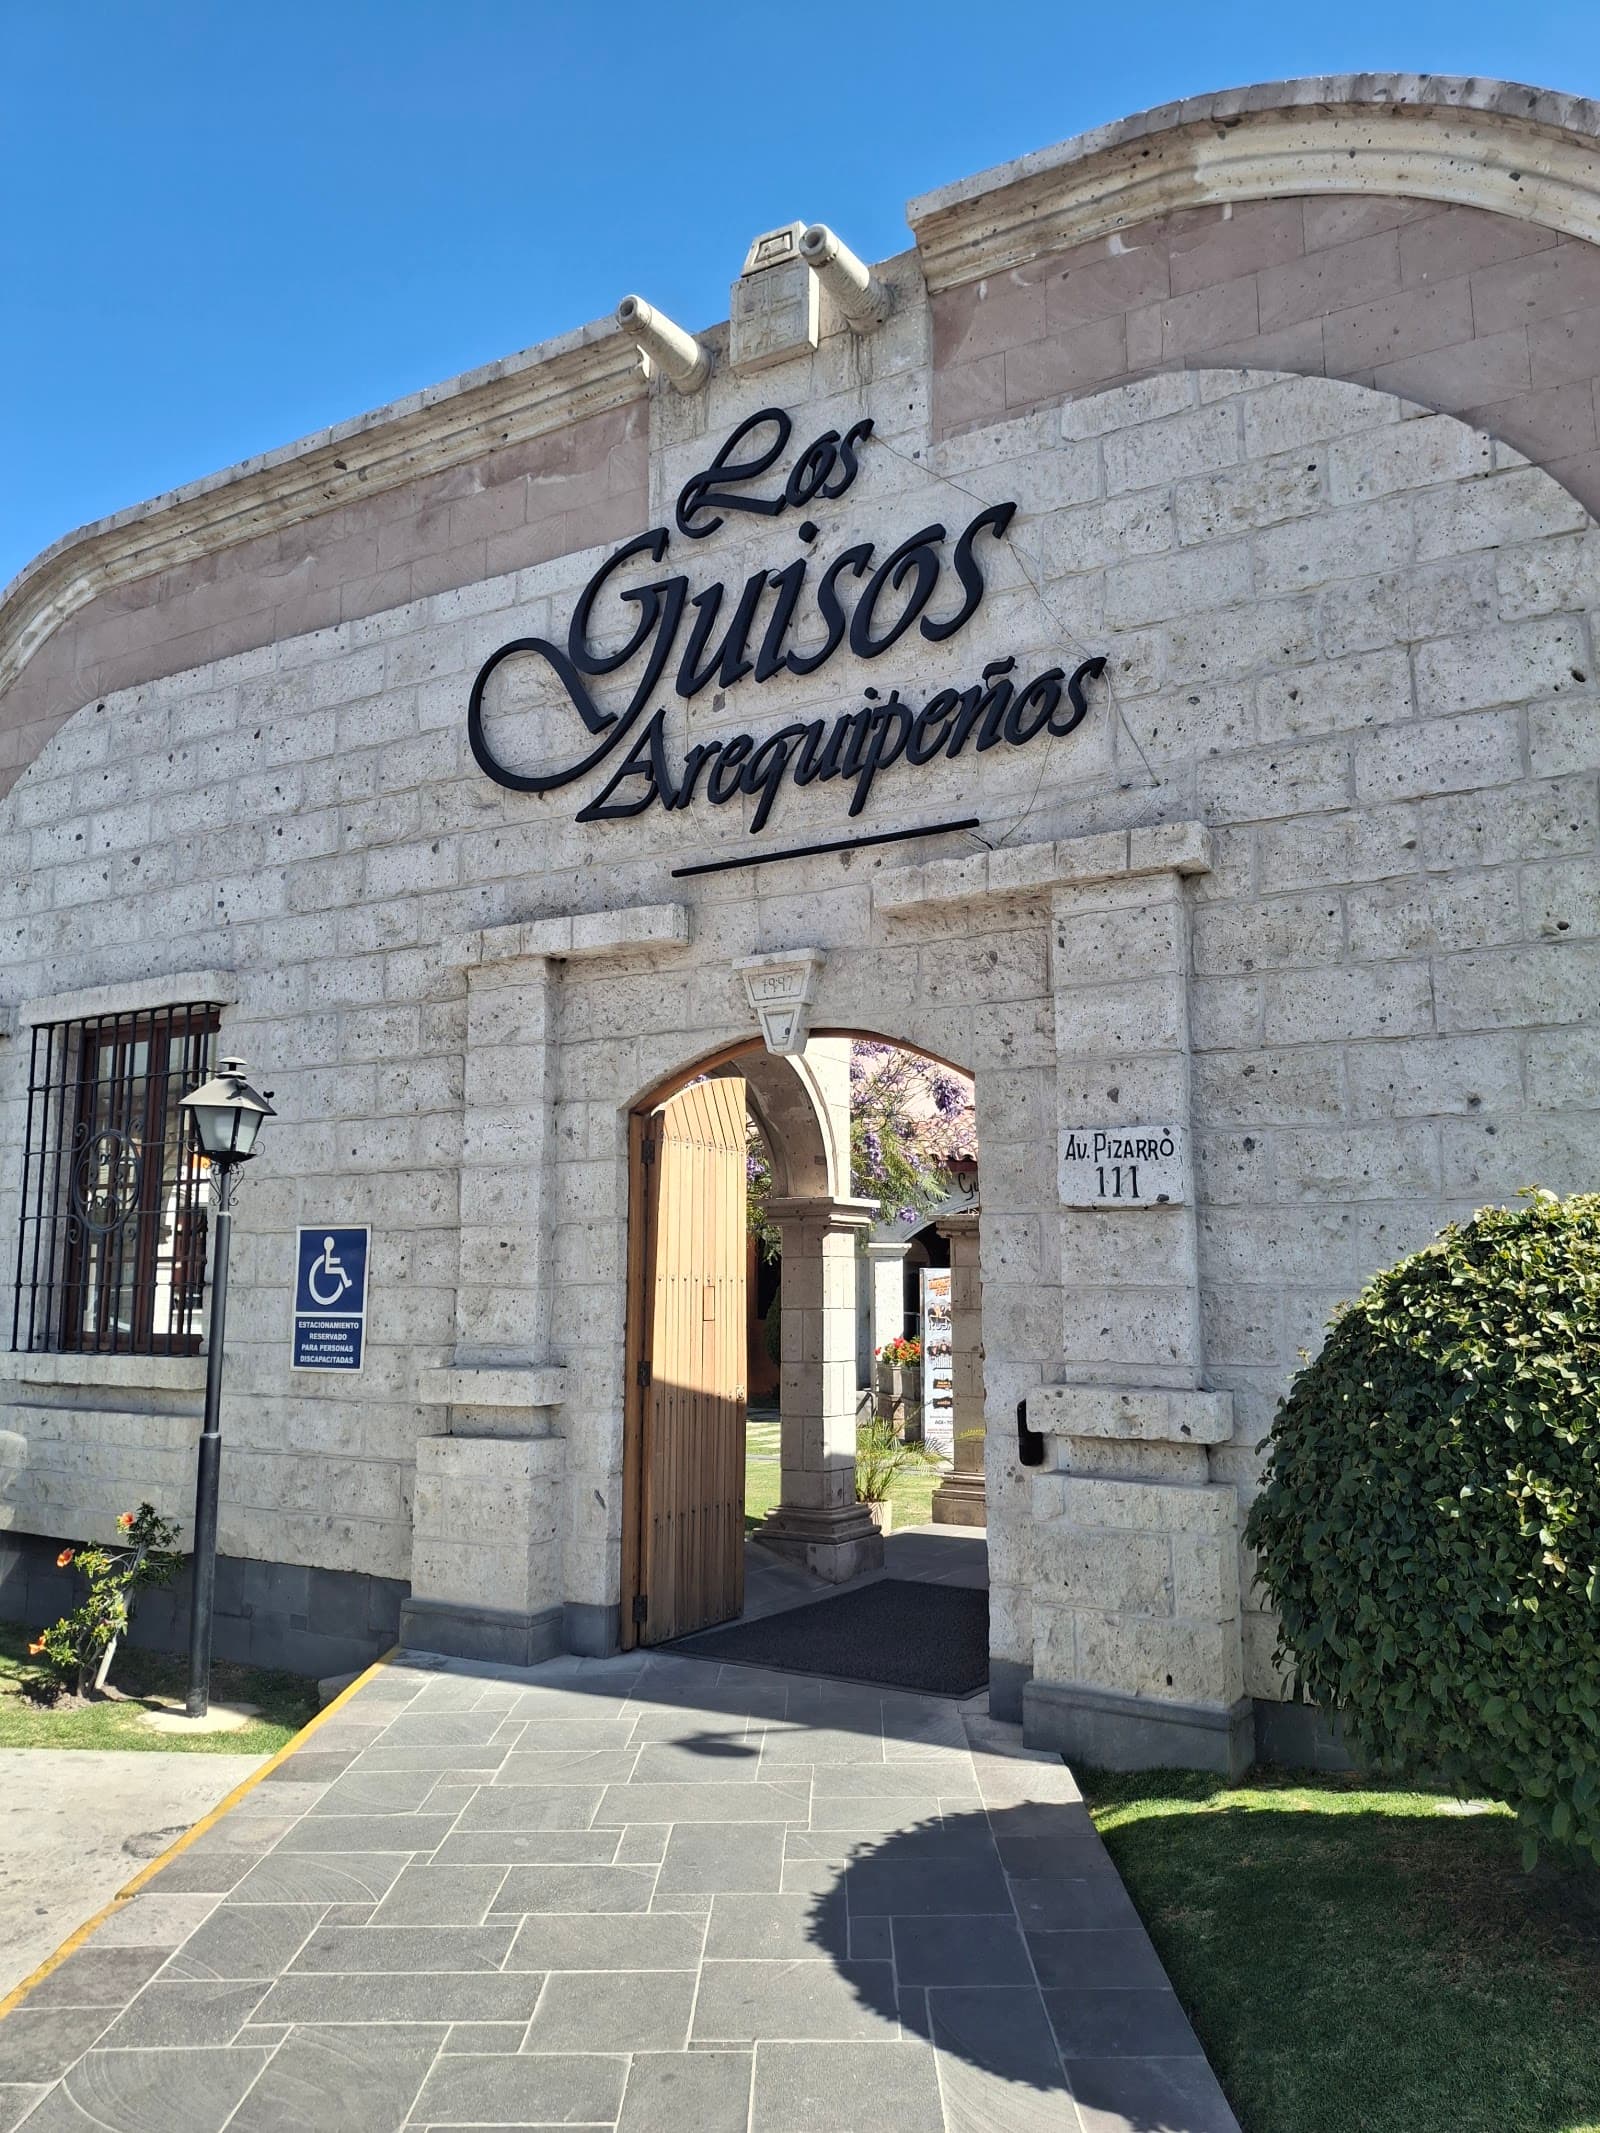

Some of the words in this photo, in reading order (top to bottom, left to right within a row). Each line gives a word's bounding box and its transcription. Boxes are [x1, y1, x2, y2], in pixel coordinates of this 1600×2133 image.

[676, 407, 875, 540] Los
[467, 501, 1018, 793] Guisos
[574, 655, 1108, 835] Arequipeños
[1095, 1165, 1140, 1198] 111
[298, 1321, 359, 1329] ESTACIONAMIENTO
[300, 1355, 354, 1363] DISCAPACITADAS
[319, 1344, 353, 1352] PERSONAS
